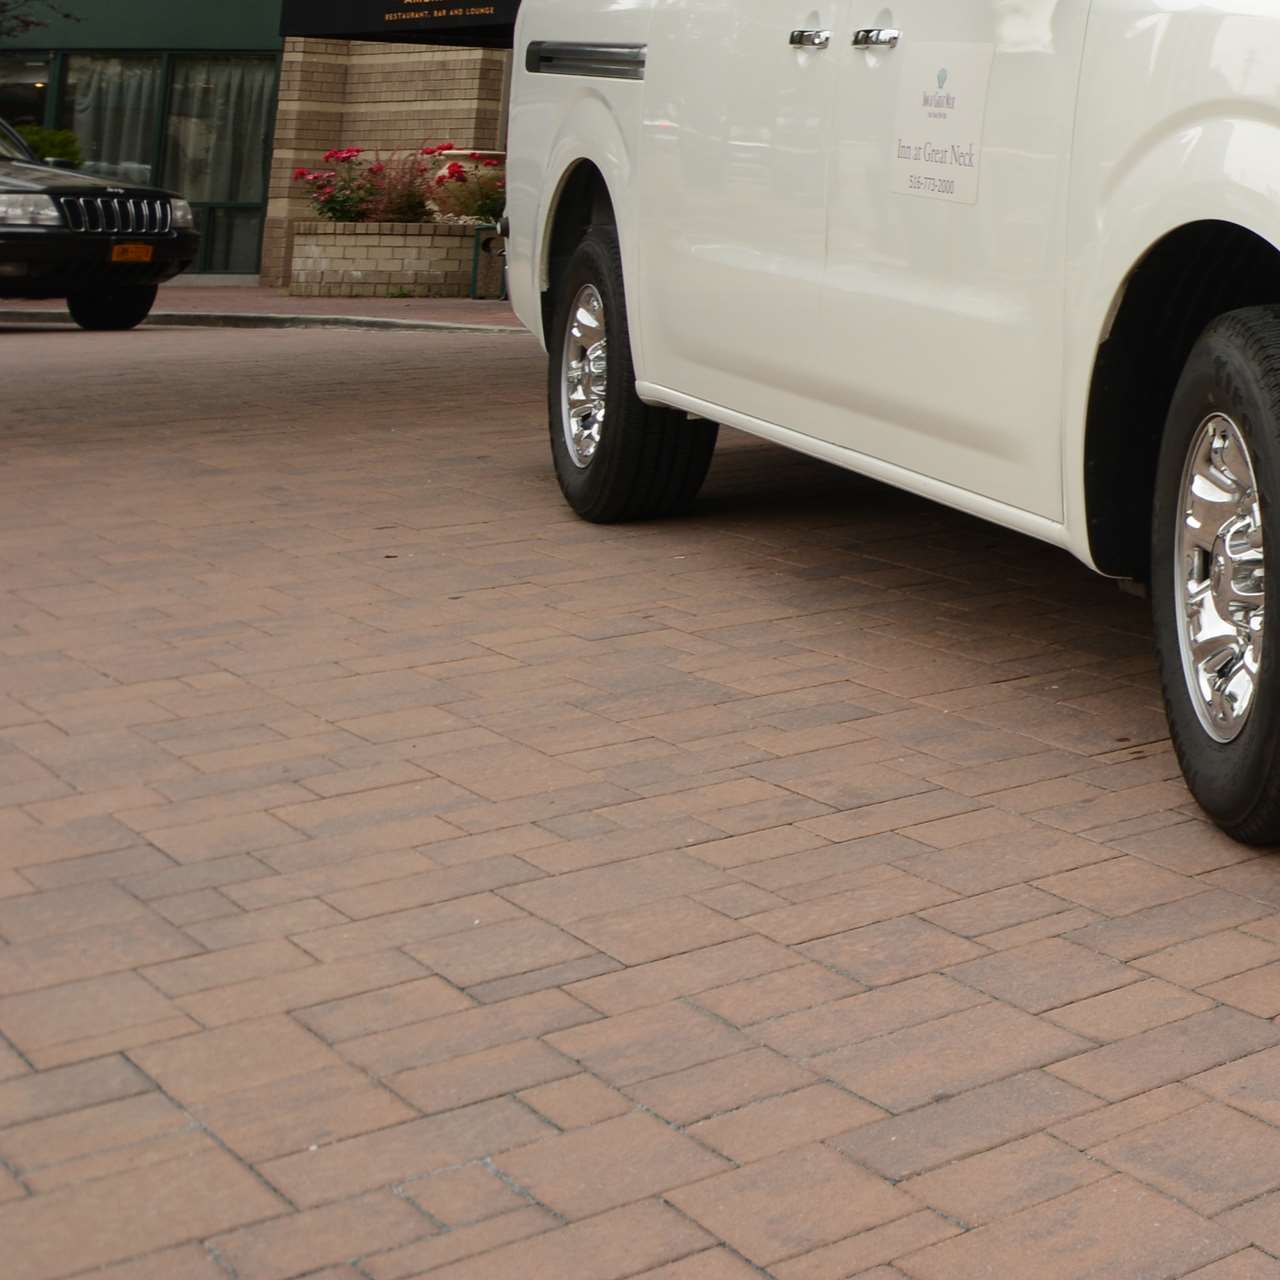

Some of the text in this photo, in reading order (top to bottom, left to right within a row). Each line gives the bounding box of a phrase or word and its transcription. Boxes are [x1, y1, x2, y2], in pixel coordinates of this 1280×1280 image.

[433, 9, 447, 17] BAR
[449, 8, 463, 16] AND
[465, 6, 495, 16] LOUNGE
[897, 138, 975, 167] Inn at Great Neck
